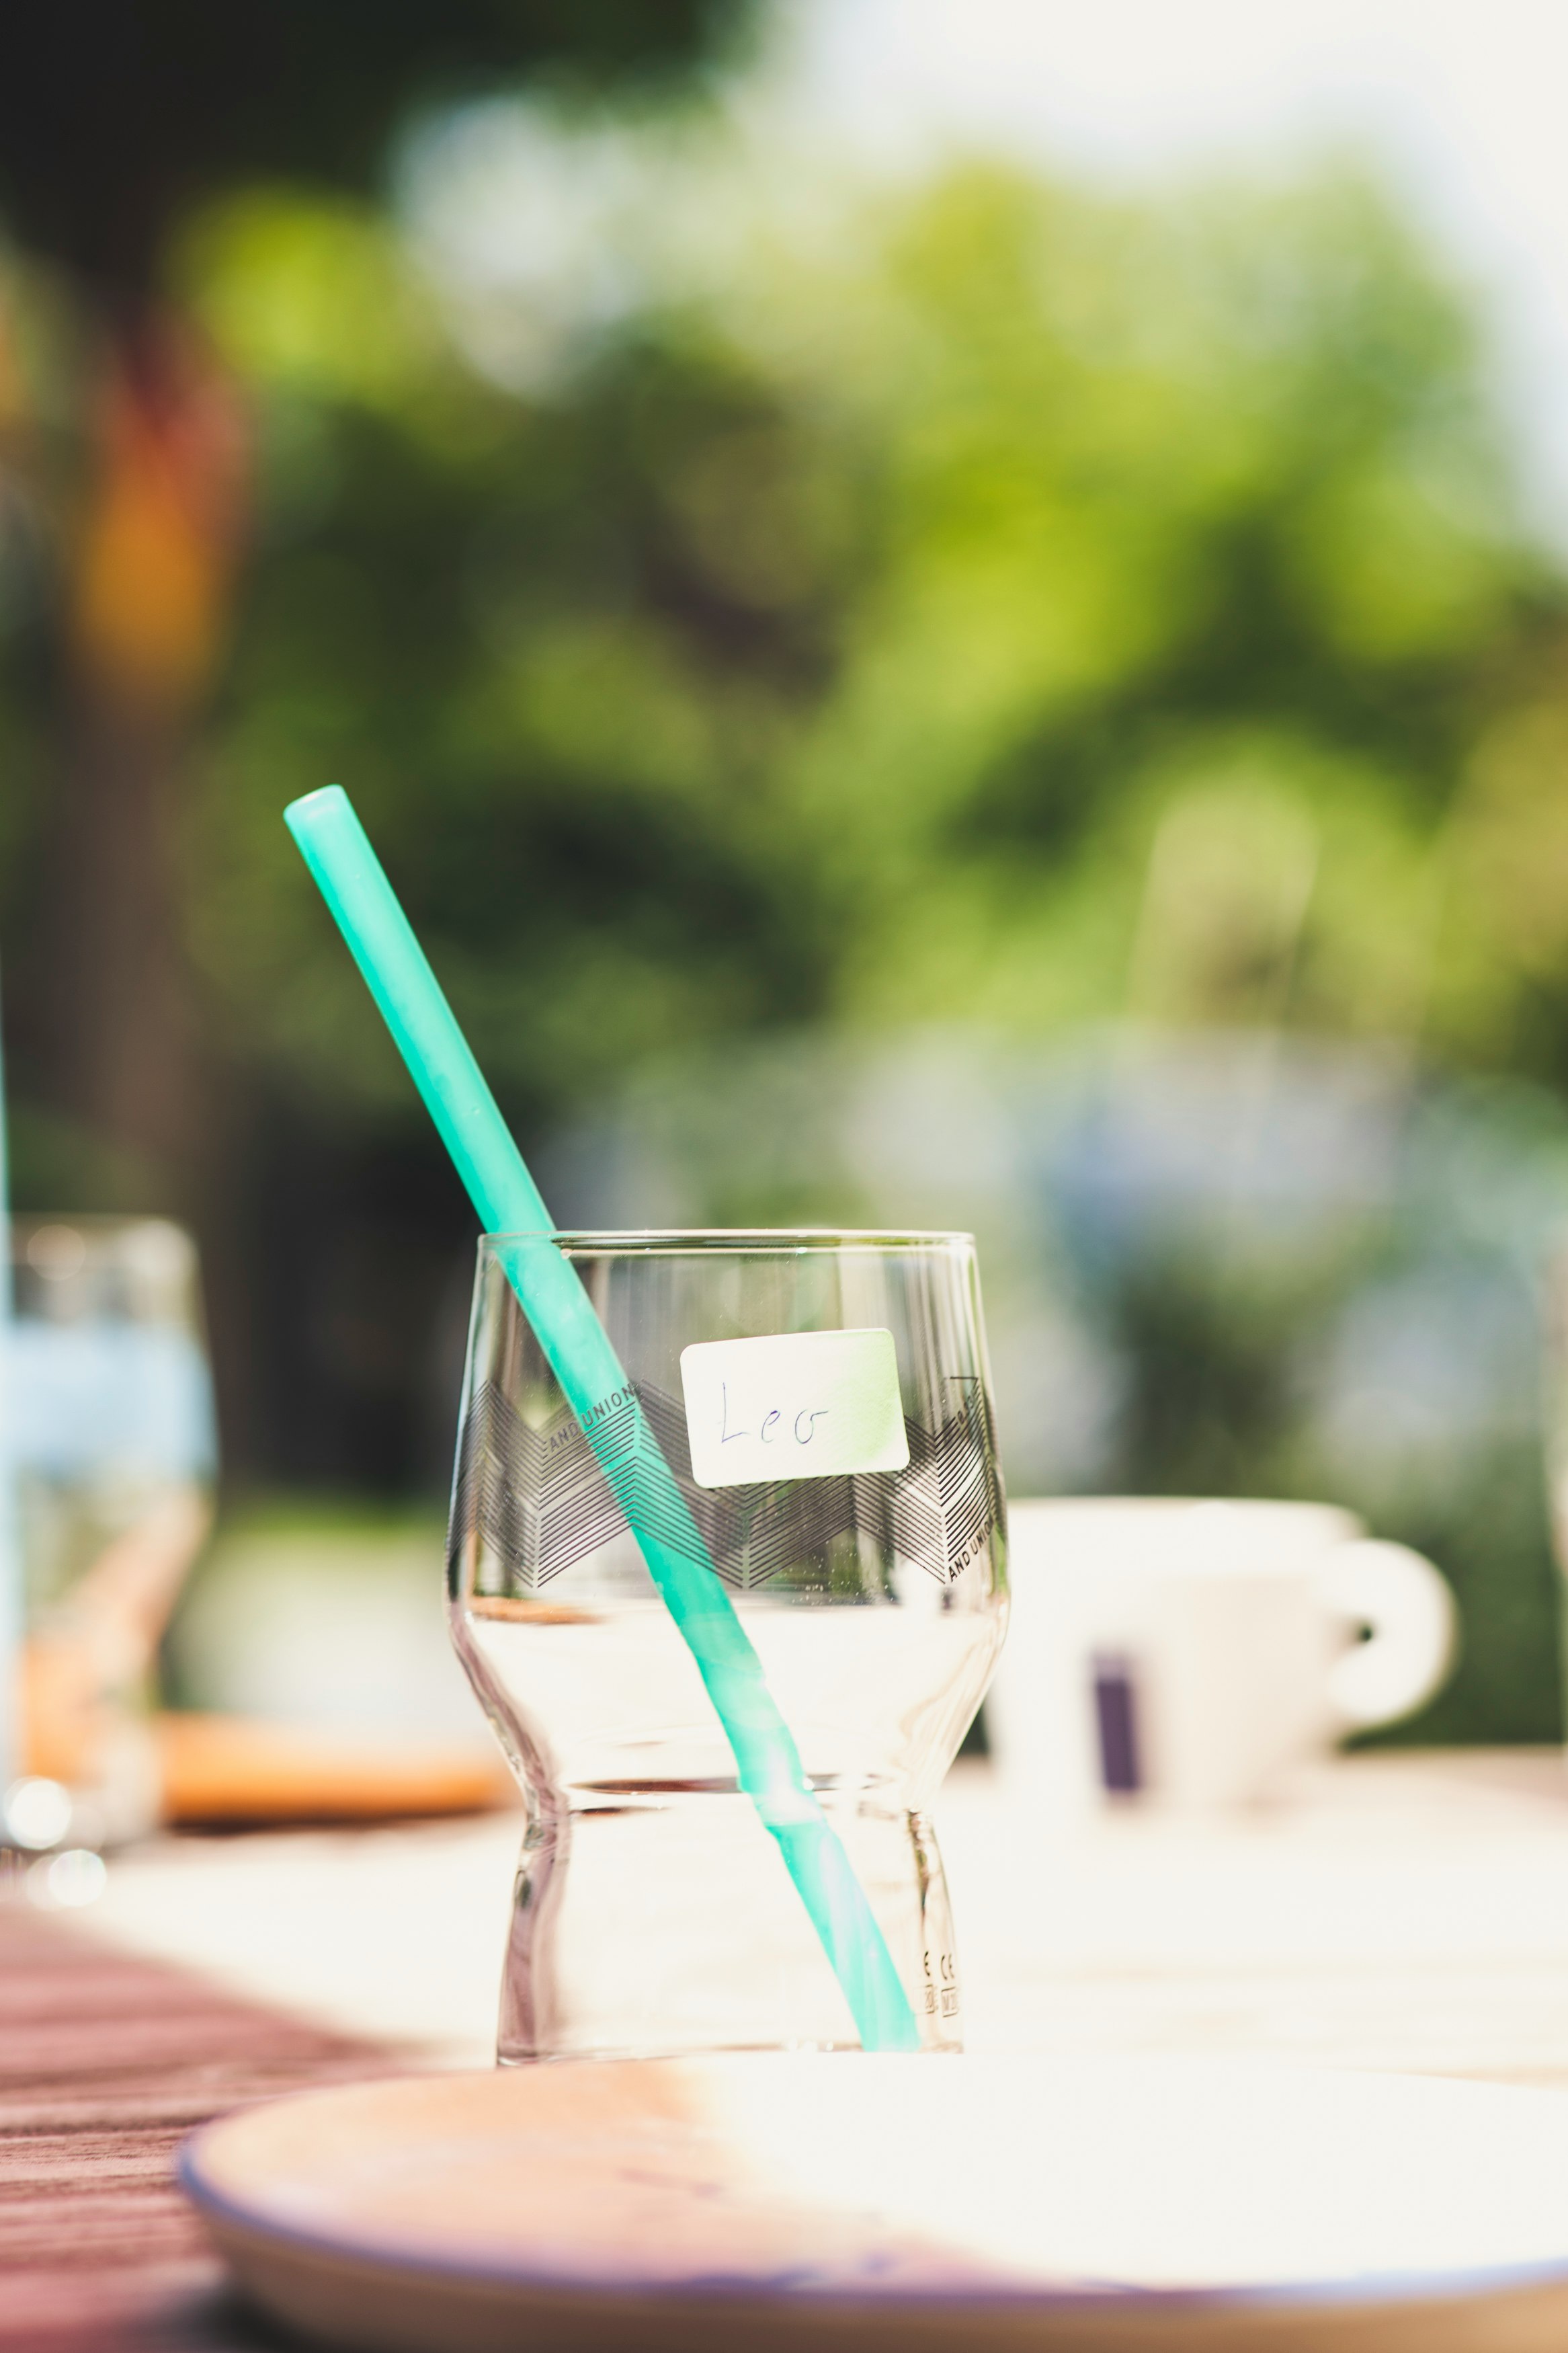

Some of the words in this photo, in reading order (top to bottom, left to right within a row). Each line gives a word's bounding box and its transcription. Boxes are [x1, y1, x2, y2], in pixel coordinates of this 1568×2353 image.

[548, 1421, 580, 1453] AND
[581, 1382, 635, 1427] UNION
[720, 1382, 829, 1445] Leo
[948, 1550, 971, 1583] AND
